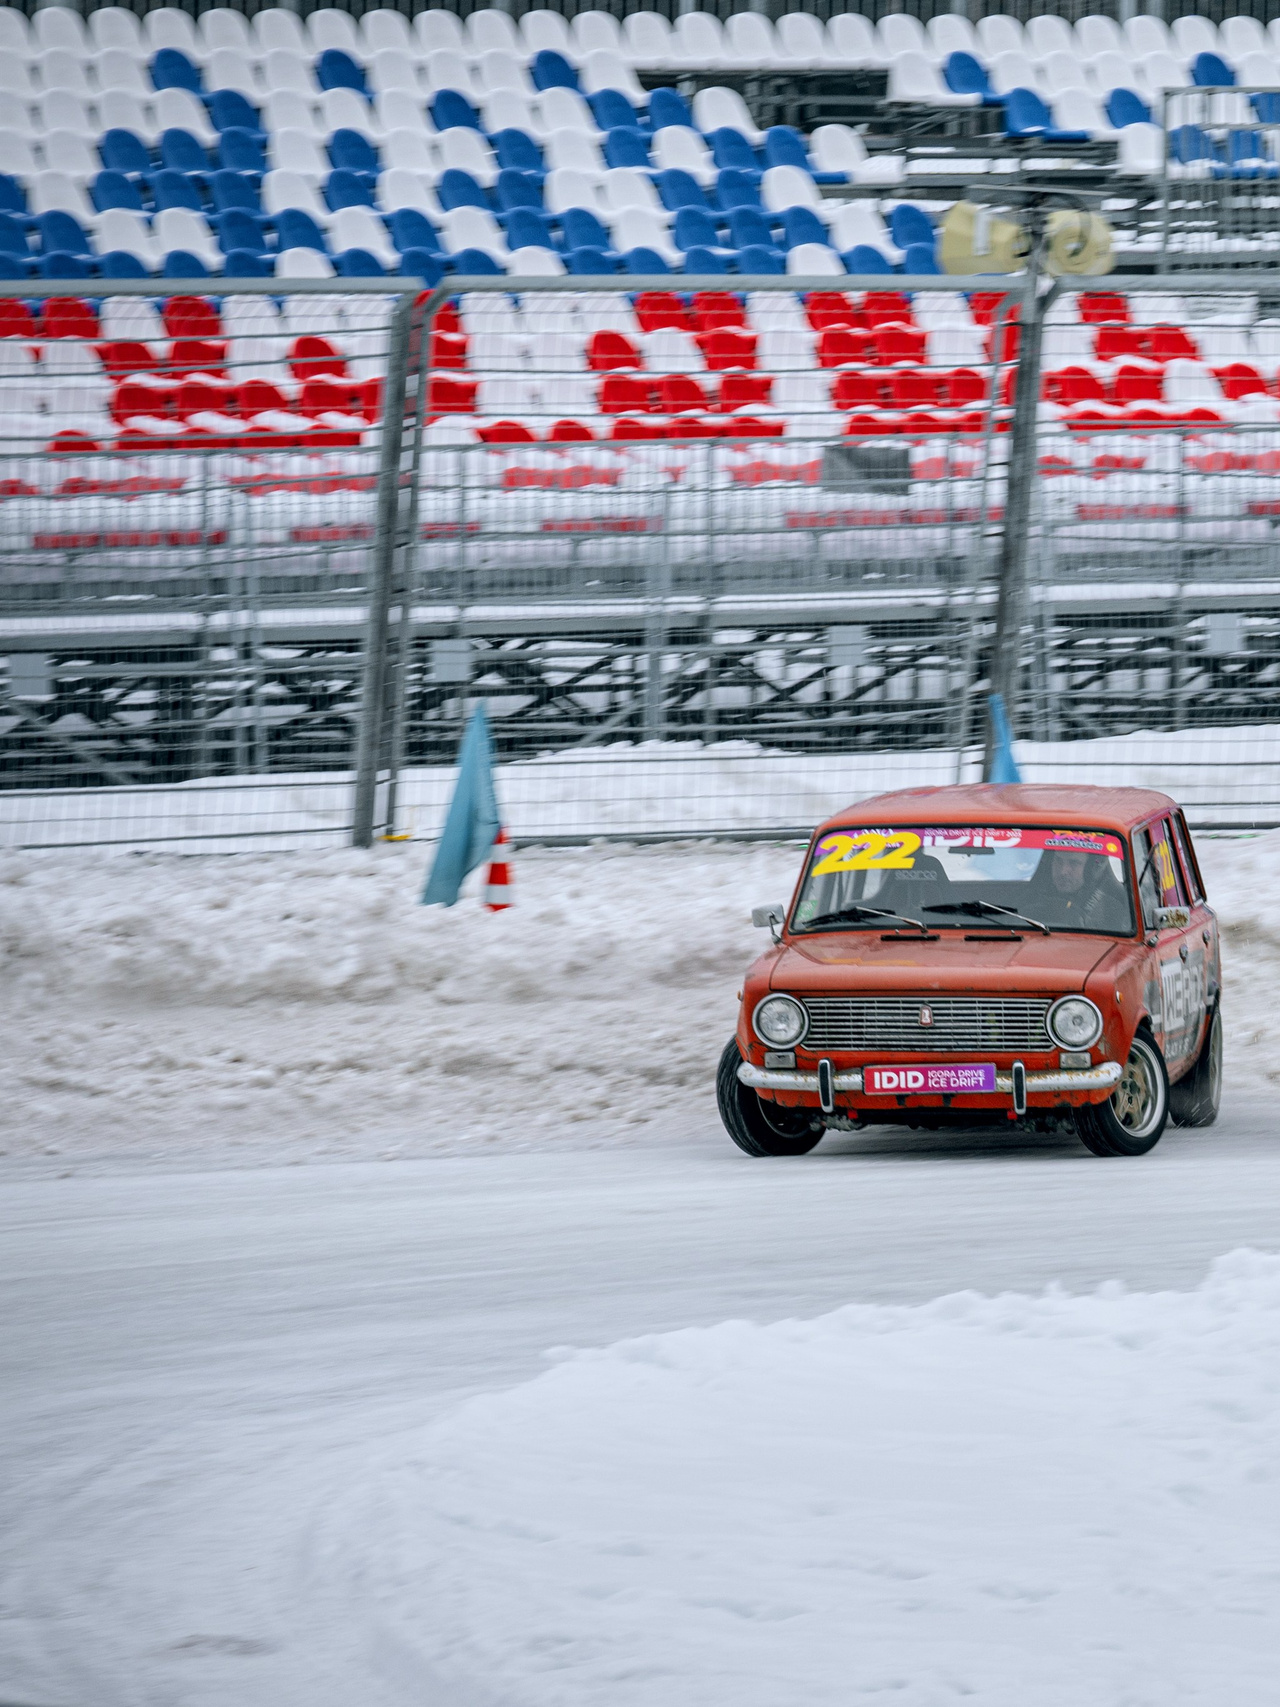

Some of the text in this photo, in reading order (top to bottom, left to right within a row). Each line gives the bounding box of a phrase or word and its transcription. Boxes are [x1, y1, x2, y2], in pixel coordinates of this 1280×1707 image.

[811, 832, 921, 877] 222
[874, 1070, 924, 1089] IDID
[927, 1069, 985, 1078] IGORA DRIVE
[928, 1077, 985, 1088] ICE DRIFT
